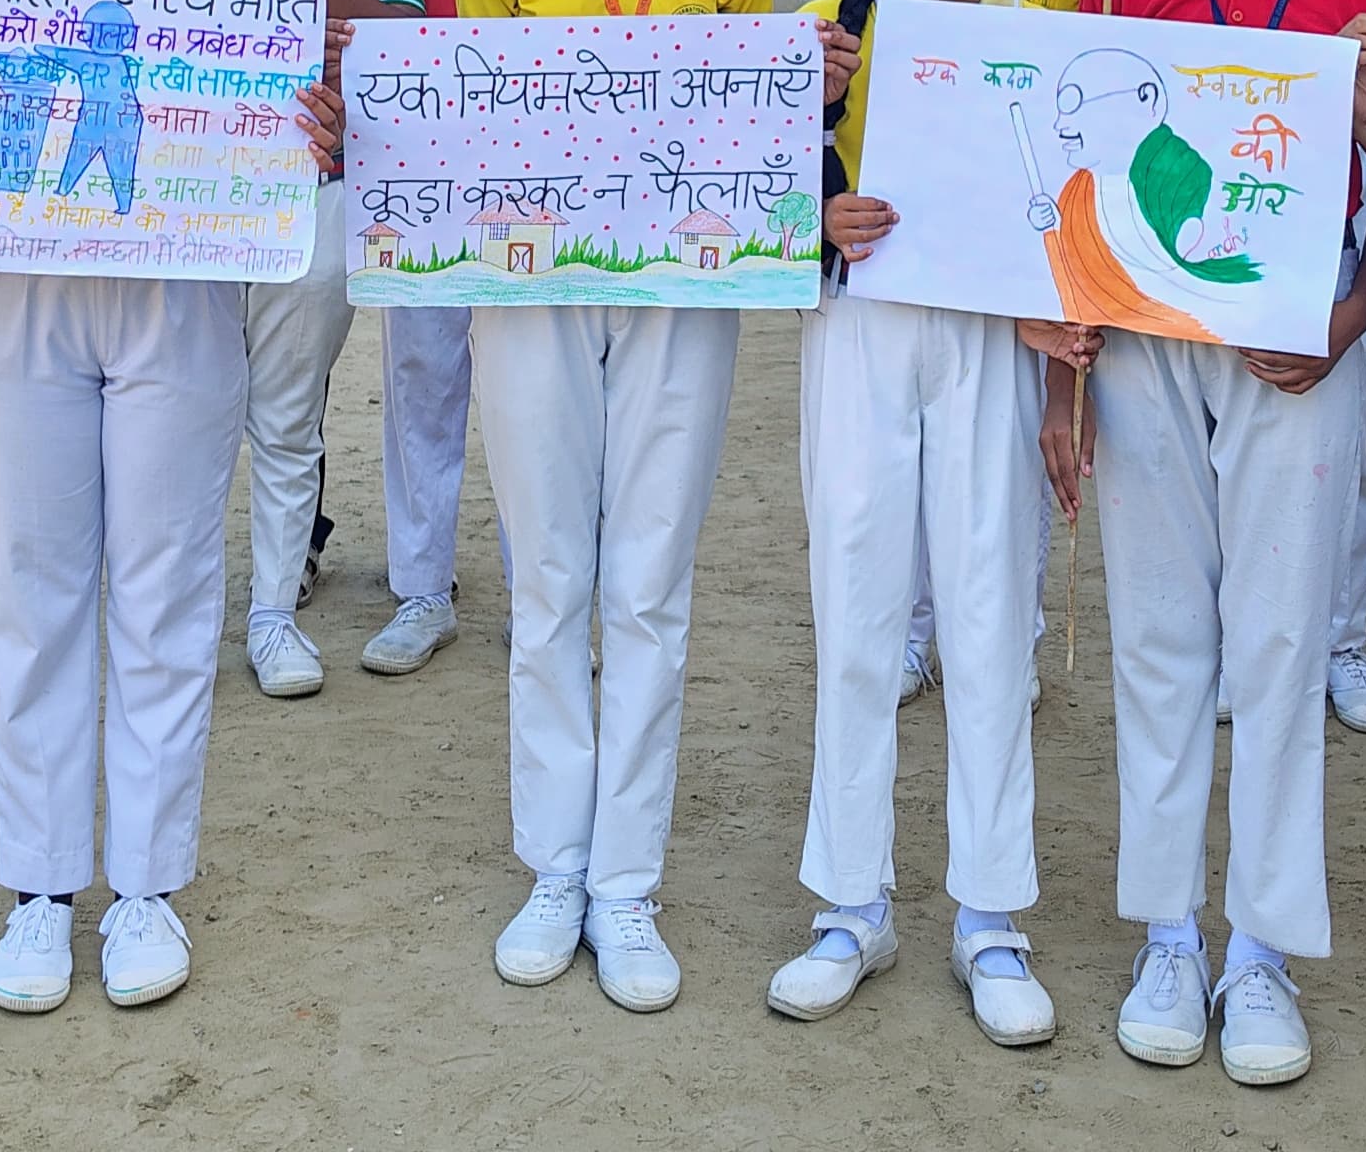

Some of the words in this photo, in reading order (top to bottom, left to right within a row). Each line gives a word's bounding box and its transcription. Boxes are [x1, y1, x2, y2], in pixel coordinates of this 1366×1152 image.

[146, 26, 177, 52] का
[186, 24, 253, 59] प्रबंध
[253, 25, 304, 63] करो
[356, 70, 442, 120] एक
[670, 50, 820, 109] अपनाएँ
[911, 56, 960, 86] एक
[980, 59, 1043, 90] कदम
[148, 107, 210, 135] नाता
[1230, 113, 1302, 174] की
[155, 176, 219, 204] भारत
[362, 178, 455, 228] कूड़ा
[463, 175, 586, 217] करकट
[594, 174, 633, 211] न
[639, 141, 799, 214] फैलाएँ
[135, 203, 166, 232] को
